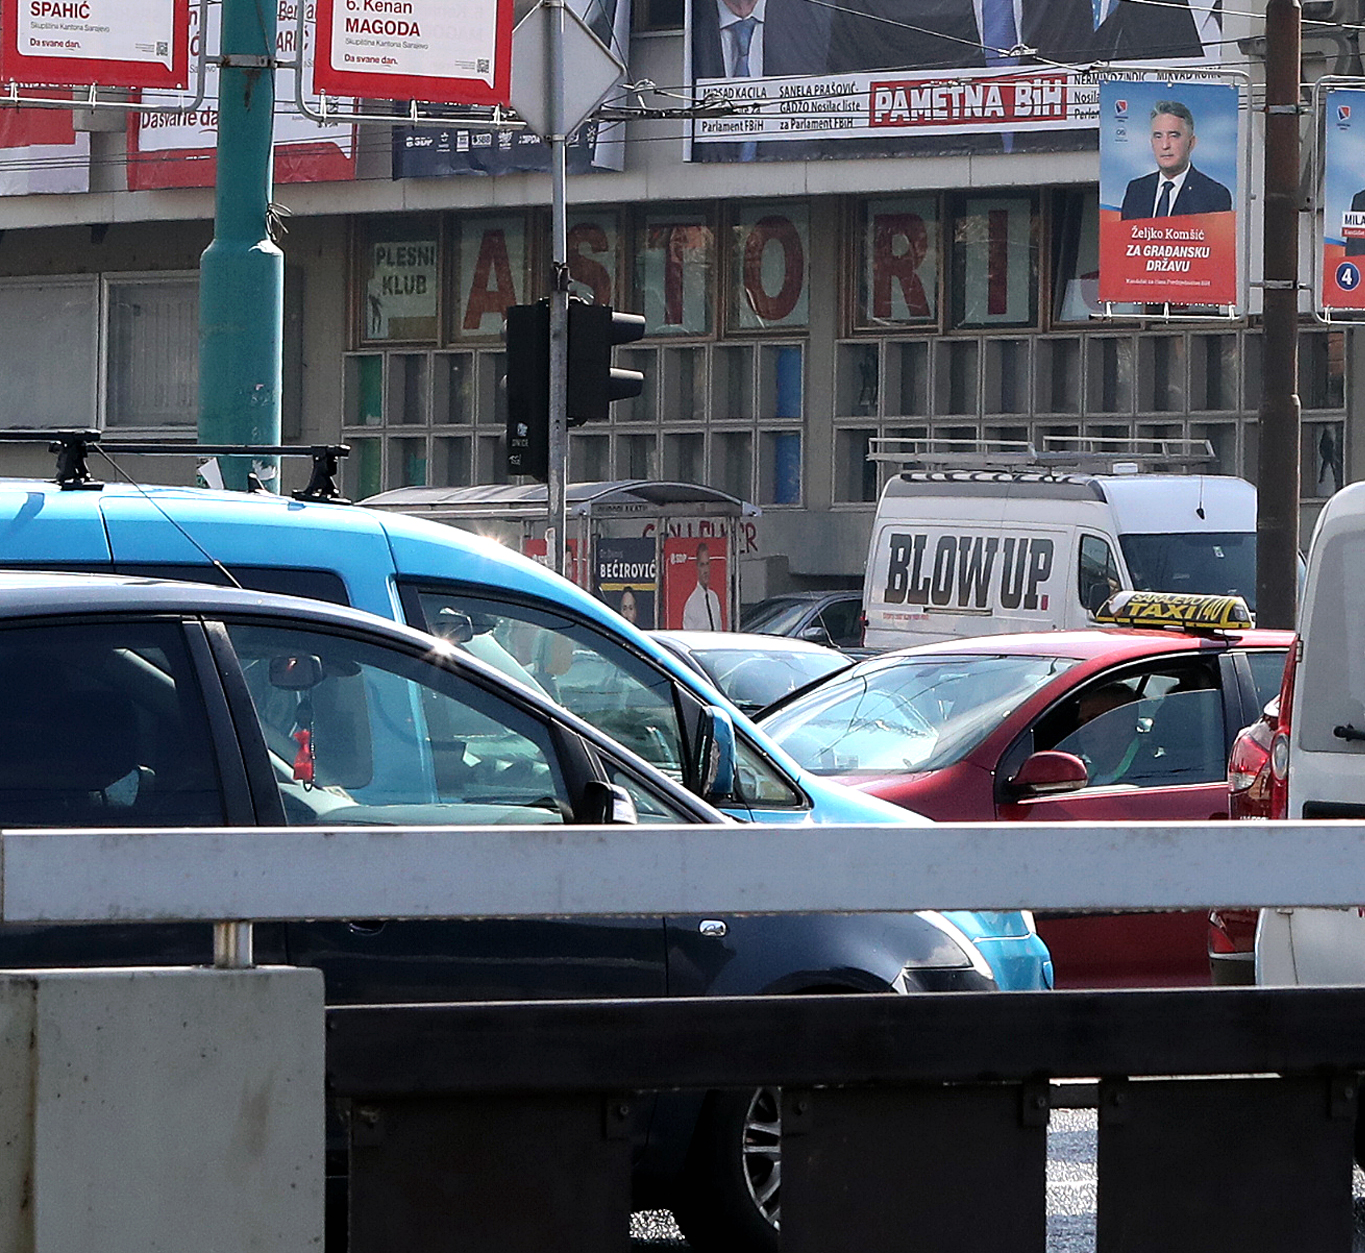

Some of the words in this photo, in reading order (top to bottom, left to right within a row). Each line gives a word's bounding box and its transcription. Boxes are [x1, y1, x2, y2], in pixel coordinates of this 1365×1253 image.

[30, 1, 90, 19] SPAHIĆ
[345, 18, 420, 37] MAGODA
[30, 38, 40, 46] Da
[344, 54, 354, 63] Da
[877, 82, 1005, 122] PAMETNA
[1014, 77, 1064, 116] BiH
[702, 121, 744, 133] Parlament
[1131, 224, 1163, 241] Željko
[1165, 228, 1205, 240] Komšić
[375, 246, 437, 267] PLESNI
[1126, 245, 1141, 256] ZA
[1146, 257, 1190, 272] DRŽAVU
[382, 274, 427, 295] KLUB
[1341, 268, 1353, 285] 4
[600, 559, 656, 578] BEĆIROVIĆ
[883, 533, 999, 609] BLOW
[1000, 537, 1055, 611] UP.
[1128, 602, 1198, 619] TAXI
